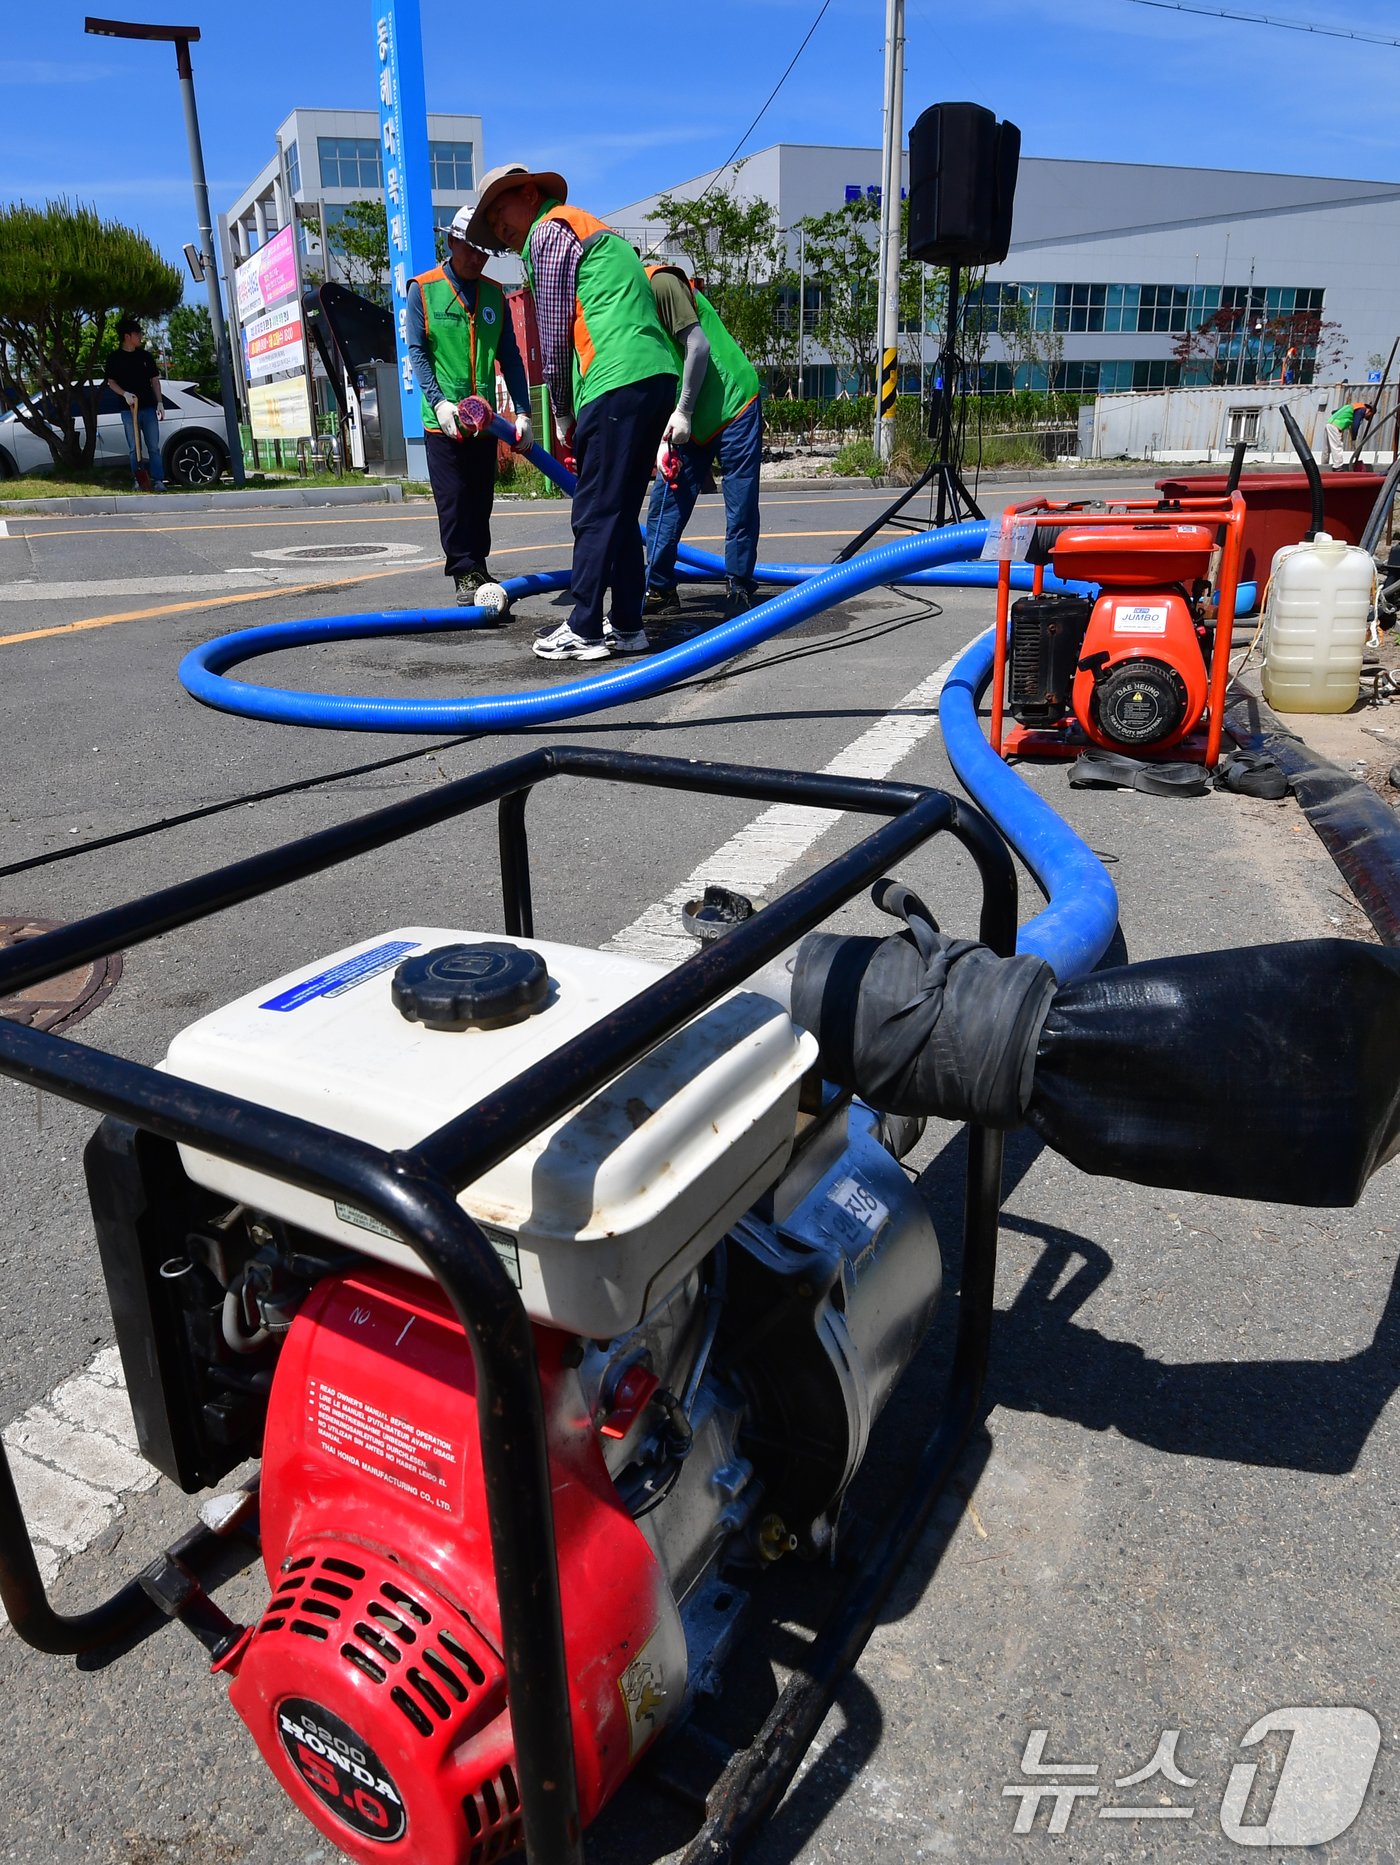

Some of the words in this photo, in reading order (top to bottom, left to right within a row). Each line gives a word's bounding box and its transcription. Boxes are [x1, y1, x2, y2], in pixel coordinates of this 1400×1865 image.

[392, 79, 402, 170] Multipurpose
[400, 175, 408, 251] Gymnasium
[1117, 684, 1132, 696] DAE
[1134, 683, 1160, 697] HEUNG
[1110, 714, 1123, 730] HEAVY
[1136, 717, 1163, 735] INDUSTRIAL
[349, 1307, 376, 1327] NO.
[318, 1402, 330, 1413] VOR
[332, 1409, 381, 1436] INBETRIEBNAHME
[382, 1432, 416, 1453] UNBEDINGT
[318, 1428, 342, 1445] MANUAL.
[318, 1411, 384, 1448] BEDIENUNGSANLEITUNG
[386, 1444, 427, 1469] DURCHLESEN.
[319, 1393, 332, 1404] LIRE
[333, 1400, 341, 1408] LE
[342, 1404, 366, 1420] MANUEL
[367, 1416, 410, 1441] D'UTILISATEUR
[411, 1437, 432, 1451] AVANT
[433, 1447, 456, 1464] USAGE.
[320, 1384, 336, 1396] READ
[337, 1392, 363, 1409] OWNER'S
[364, 1404, 388, 1421] MANUAL
[390, 1416, 414, 1434] BEFORE
[416, 1430, 452, 1451] OPERATION.
[318, 1420, 326, 1428] NO
[328, 1424, 352, 1441] UTILIZAR
[353, 1437, 363, 1446] SIN
[365, 1443, 384, 1456] ANTES
[386, 1453, 394, 1461] NO
[396, 1458, 417, 1473] HABER
[419, 1469, 437, 1482] LEIDO
[321, 1441, 335, 1454] THAI
[337, 1450, 360, 1467] HONDA
[362, 1462, 418, 1495] MANUFACTURING
[436, 1498, 452, 1513] LTD.
[280, 1714, 401, 1805] HONDA
[301, 1715, 366, 1765] G200
[297, 1743, 389, 1829] 5.0
